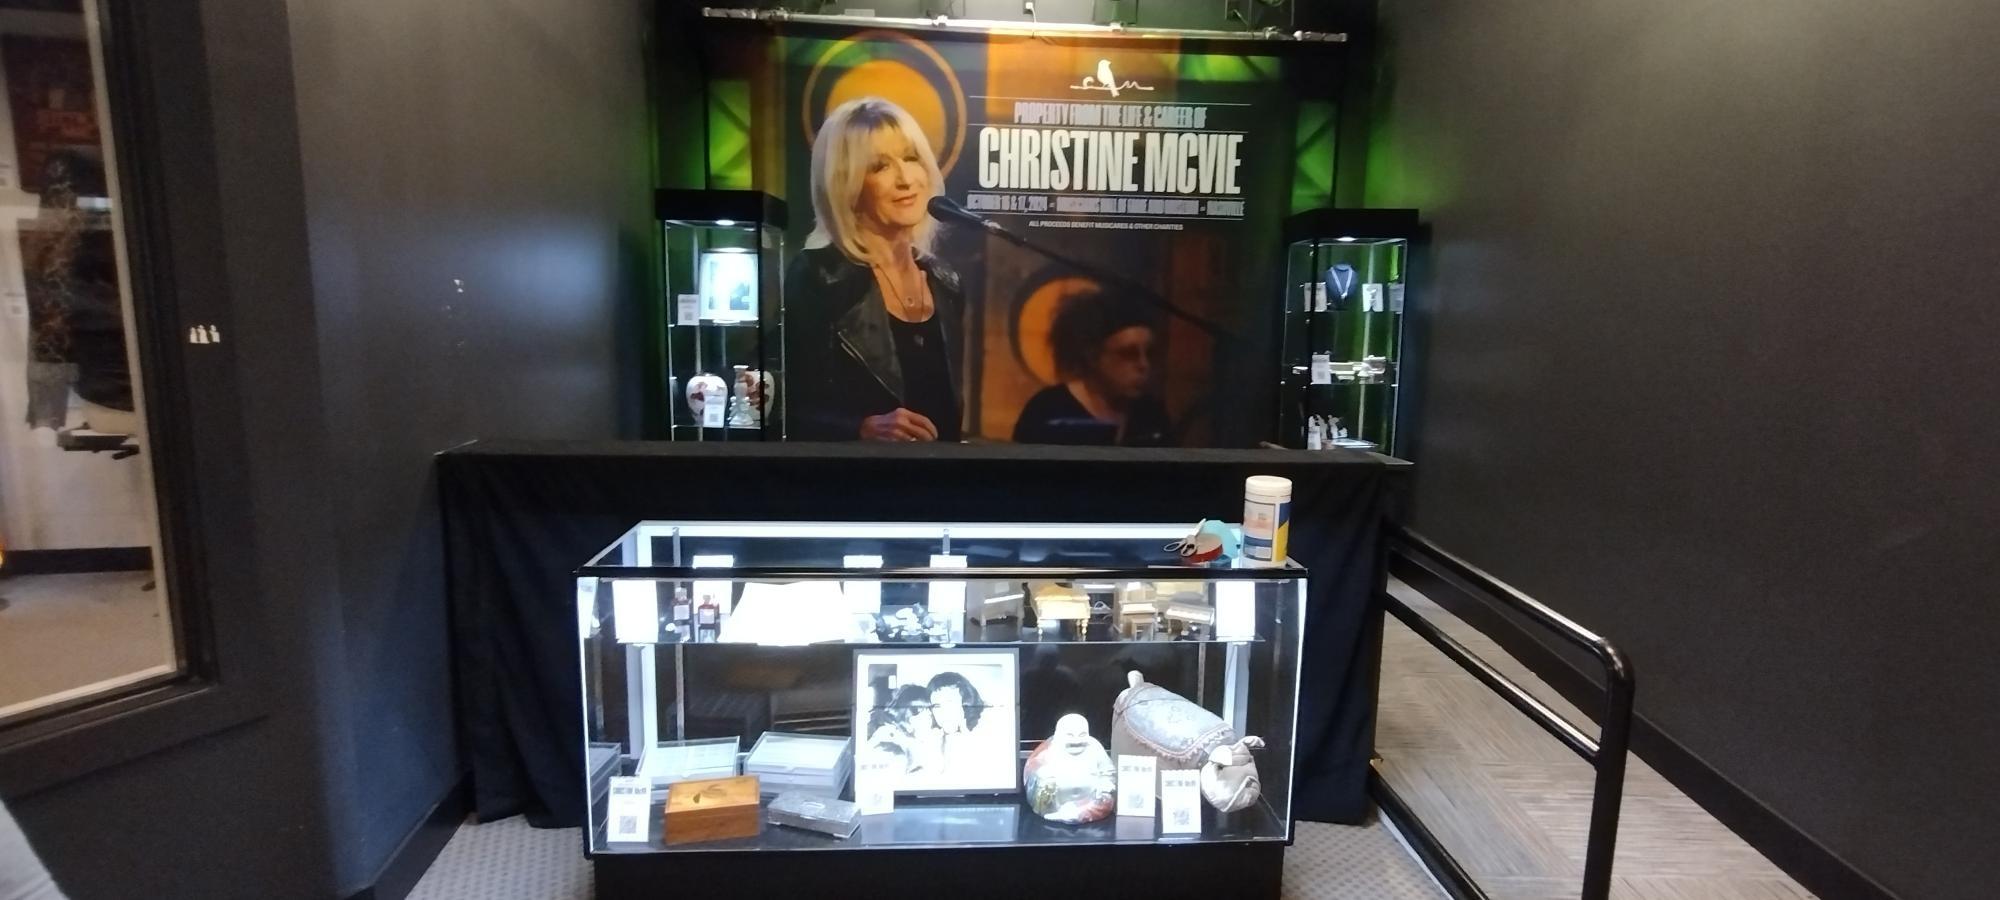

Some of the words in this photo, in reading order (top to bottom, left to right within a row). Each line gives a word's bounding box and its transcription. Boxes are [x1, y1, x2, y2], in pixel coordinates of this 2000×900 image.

[1014, 102, 1069, 124] PROPERTY
[1122, 105, 1143, 127] LIFE
[1143, 105, 1152, 128] &
[978, 127, 1140, 193] CHRISTINE
[1144, 132, 1243, 194] MCVIE
[1028, 220, 1040, 228] ALL
